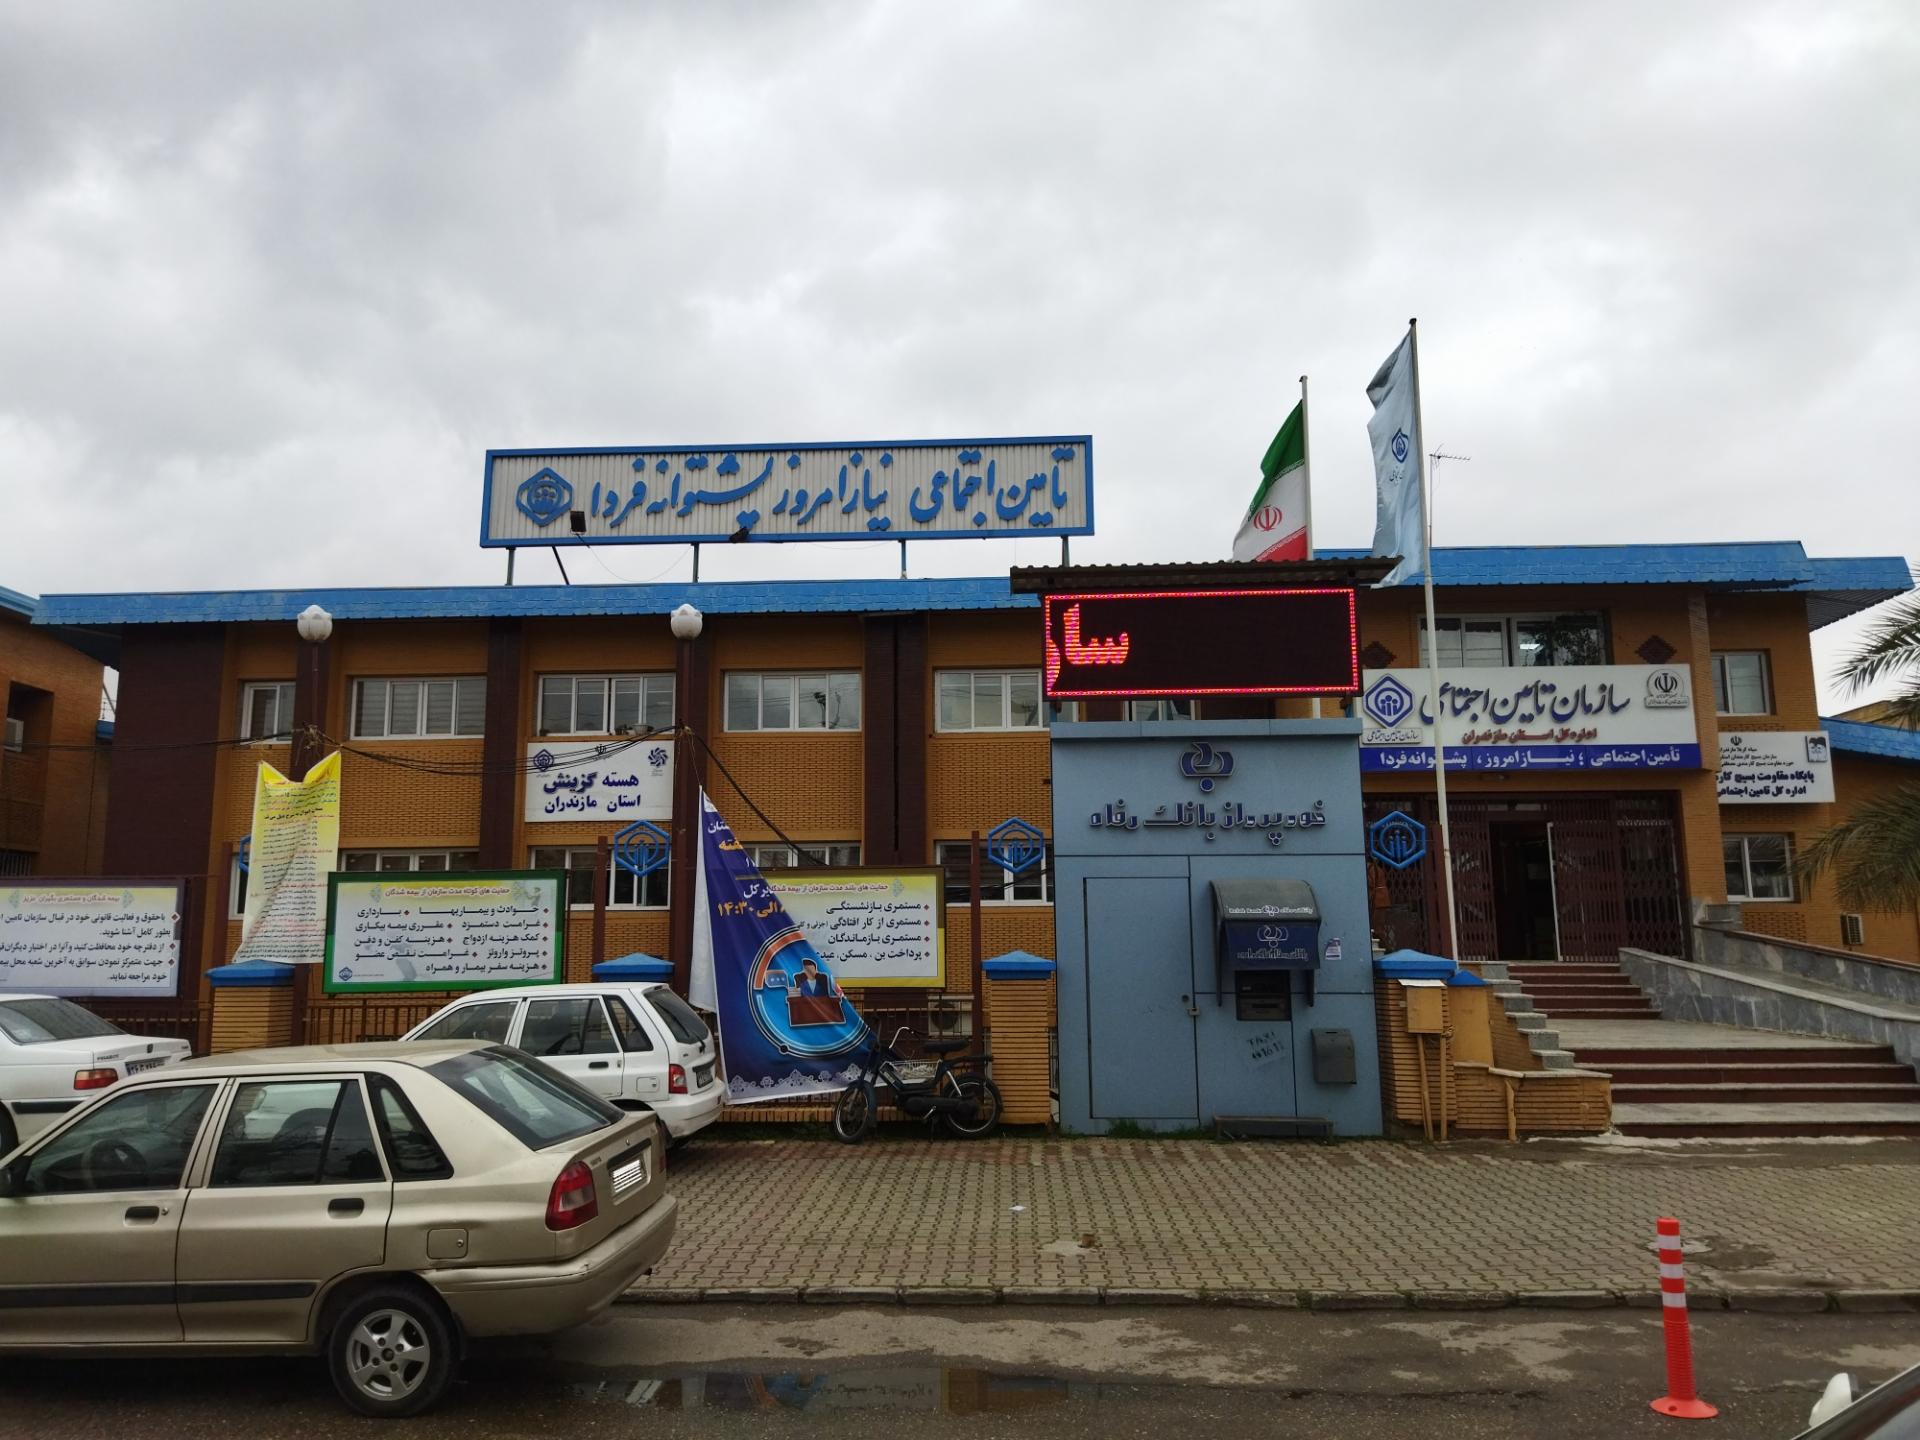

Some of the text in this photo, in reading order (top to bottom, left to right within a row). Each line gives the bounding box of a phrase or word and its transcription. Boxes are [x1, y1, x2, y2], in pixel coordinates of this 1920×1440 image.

[591, 457, 647, 528] فردا
[910, 449, 996, 524] اجتماعی
[1419, 682, 1490, 725] اجتماعی
[1550, 682, 1631, 723] سازمان
[1461, 728, 1598, 745] اداره کل استان مازندران
[1379, 750, 1408, 768] فردا
[1520, 749, 1575, 768] نیاز
[1590, 749, 1646, 767] اجتماعی
[543, 771, 598, 794] گزینش
[602, 771, 640, 788] هسته
[1734, 773, 1756, 784] بسیج
[1756, 770, 1789, 784] مقاومت
[1789, 770, 1815, 784] پایگاه
[1771, 786, 1784, 797] کل
[1785, 785, 1807, 798] اداره
[544, 794, 642, 814] استان مازندران
[1089, 799, 1327, 846] خودپرداز بانک رفاه
[356, 907, 402, 919] بارداری
[496, 904, 539, 917] حوادث
[826, 900, 922, 914] مستمری بازنشستگی
[23, 912, 47, 924] سازمان
[65, 914, 74, 924] در
[75, 913, 90, 924] خود
[829, 917, 860, 930] افتادگی
[861, 917, 874, 930] کار
[876, 917, 884, 929] از
[885, 917, 922, 929] مستمری
[121, 926, 137, 936] آشنا
[355, 920, 445, 933] مقرری بیمه بیکاری
[461, 919, 541, 931] غرامت دستمزد
[136, 927, 154, 939] کامل
[462, 933, 540, 946] کمک هزینه ازدواج
[827, 932, 922, 946] مستمری بازماندگان
[353, 935, 377, 947] دفن
[383, 935, 404, 947] کفن
[405, 935, 446, 946] هزینه
[117, 943, 132, 954] خود
[354, 948, 470, 962] غرامت نقص عضو
[509, 947, 540, 959] پروتز
[887, 948, 922, 961] پرداخت
[143, 959, 164, 968] جهت
[425, 963, 454, 975] همراه
[461, 962, 486, 974] بیمار
[487, 962, 508, 974] سفر
[509, 962, 540, 974] هزینه
[151, 973, 168, 983] خود
